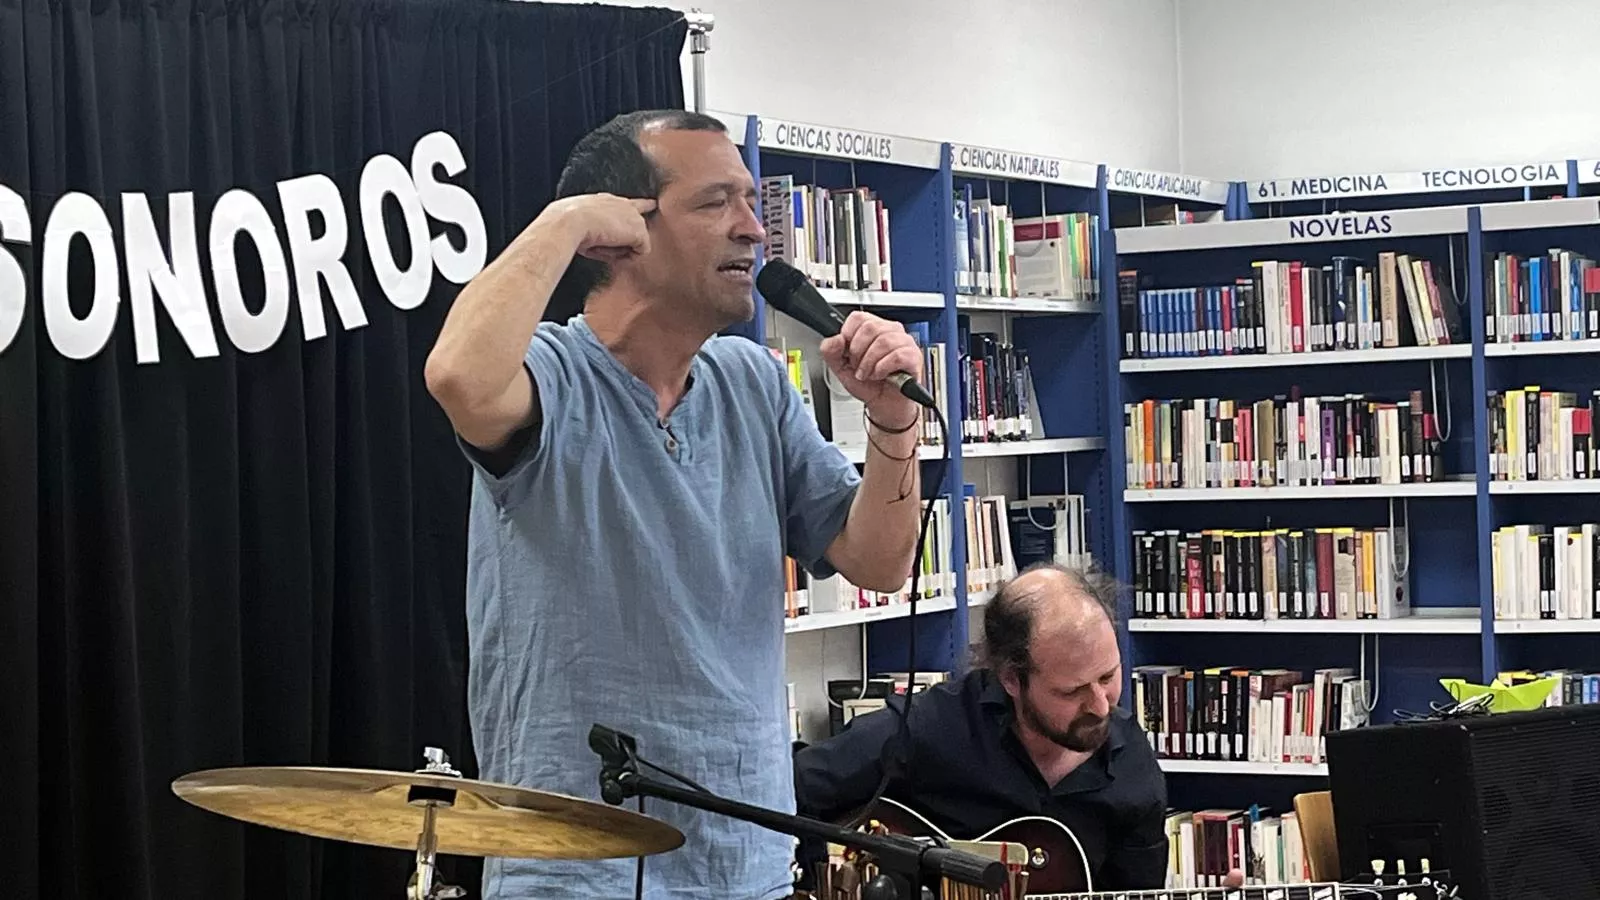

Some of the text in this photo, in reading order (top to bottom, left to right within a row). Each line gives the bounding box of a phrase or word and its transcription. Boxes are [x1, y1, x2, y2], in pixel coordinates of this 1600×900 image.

[776, 124, 831, 152] CIENCAS
[836, 132, 892, 159] SOCIALES
[960, 147, 1007, 172] CIENCIAS
[1009, 155, 1060, 179] NATURALES
[1114, 168, 1157, 190] CIENCIAS
[1156, 175, 1201, 196] APLICADAS
[1258, 164, 1560, 198] 61. MEDICINA TECNOLOGIA
[768, 180, 784, 262] DERECH
[1290, 215, 1392, 239] NOVELAS
